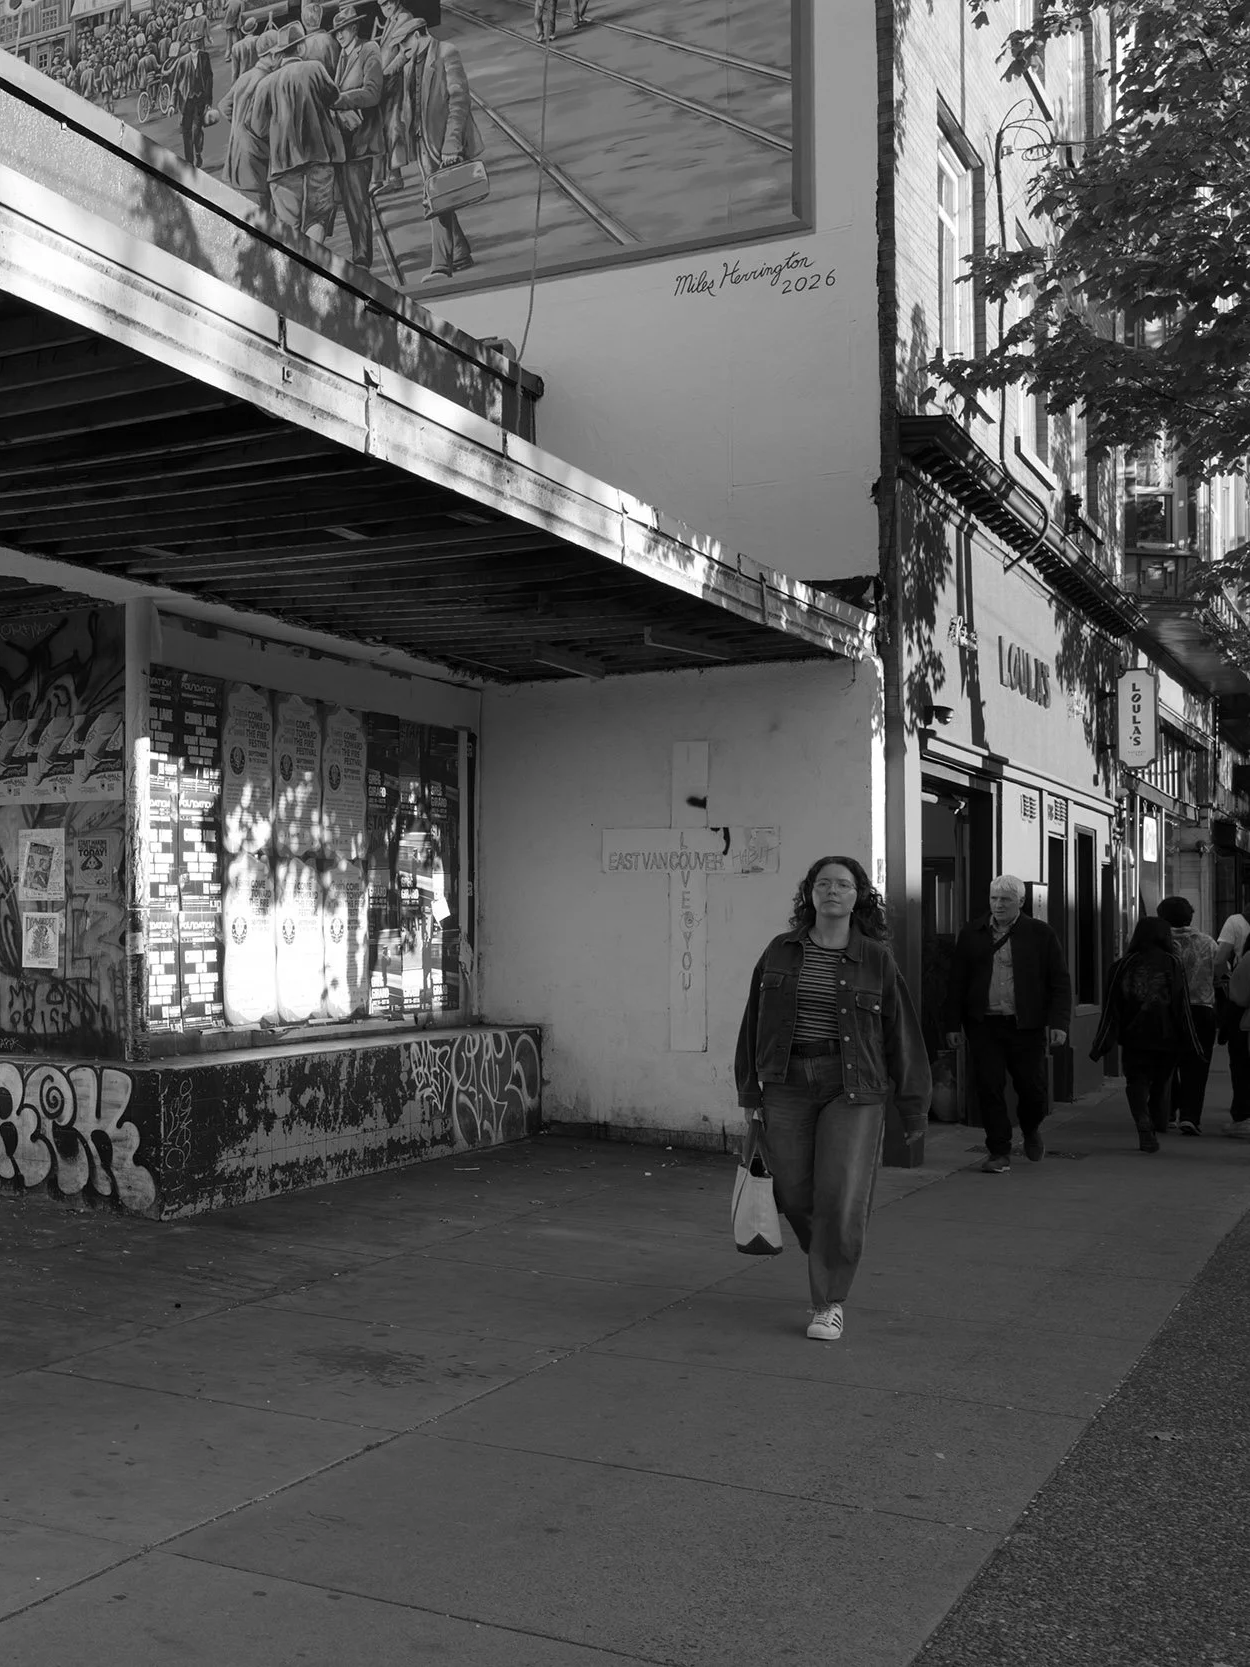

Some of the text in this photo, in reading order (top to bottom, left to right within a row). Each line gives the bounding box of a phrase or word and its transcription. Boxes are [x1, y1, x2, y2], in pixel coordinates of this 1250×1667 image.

[719, 251, 816, 289] Herrington
[781, 268, 837, 295] 2026
[78, 849, 107, 857] TODAY!
[608, 851, 725, 871] EAST VANCOUVER
